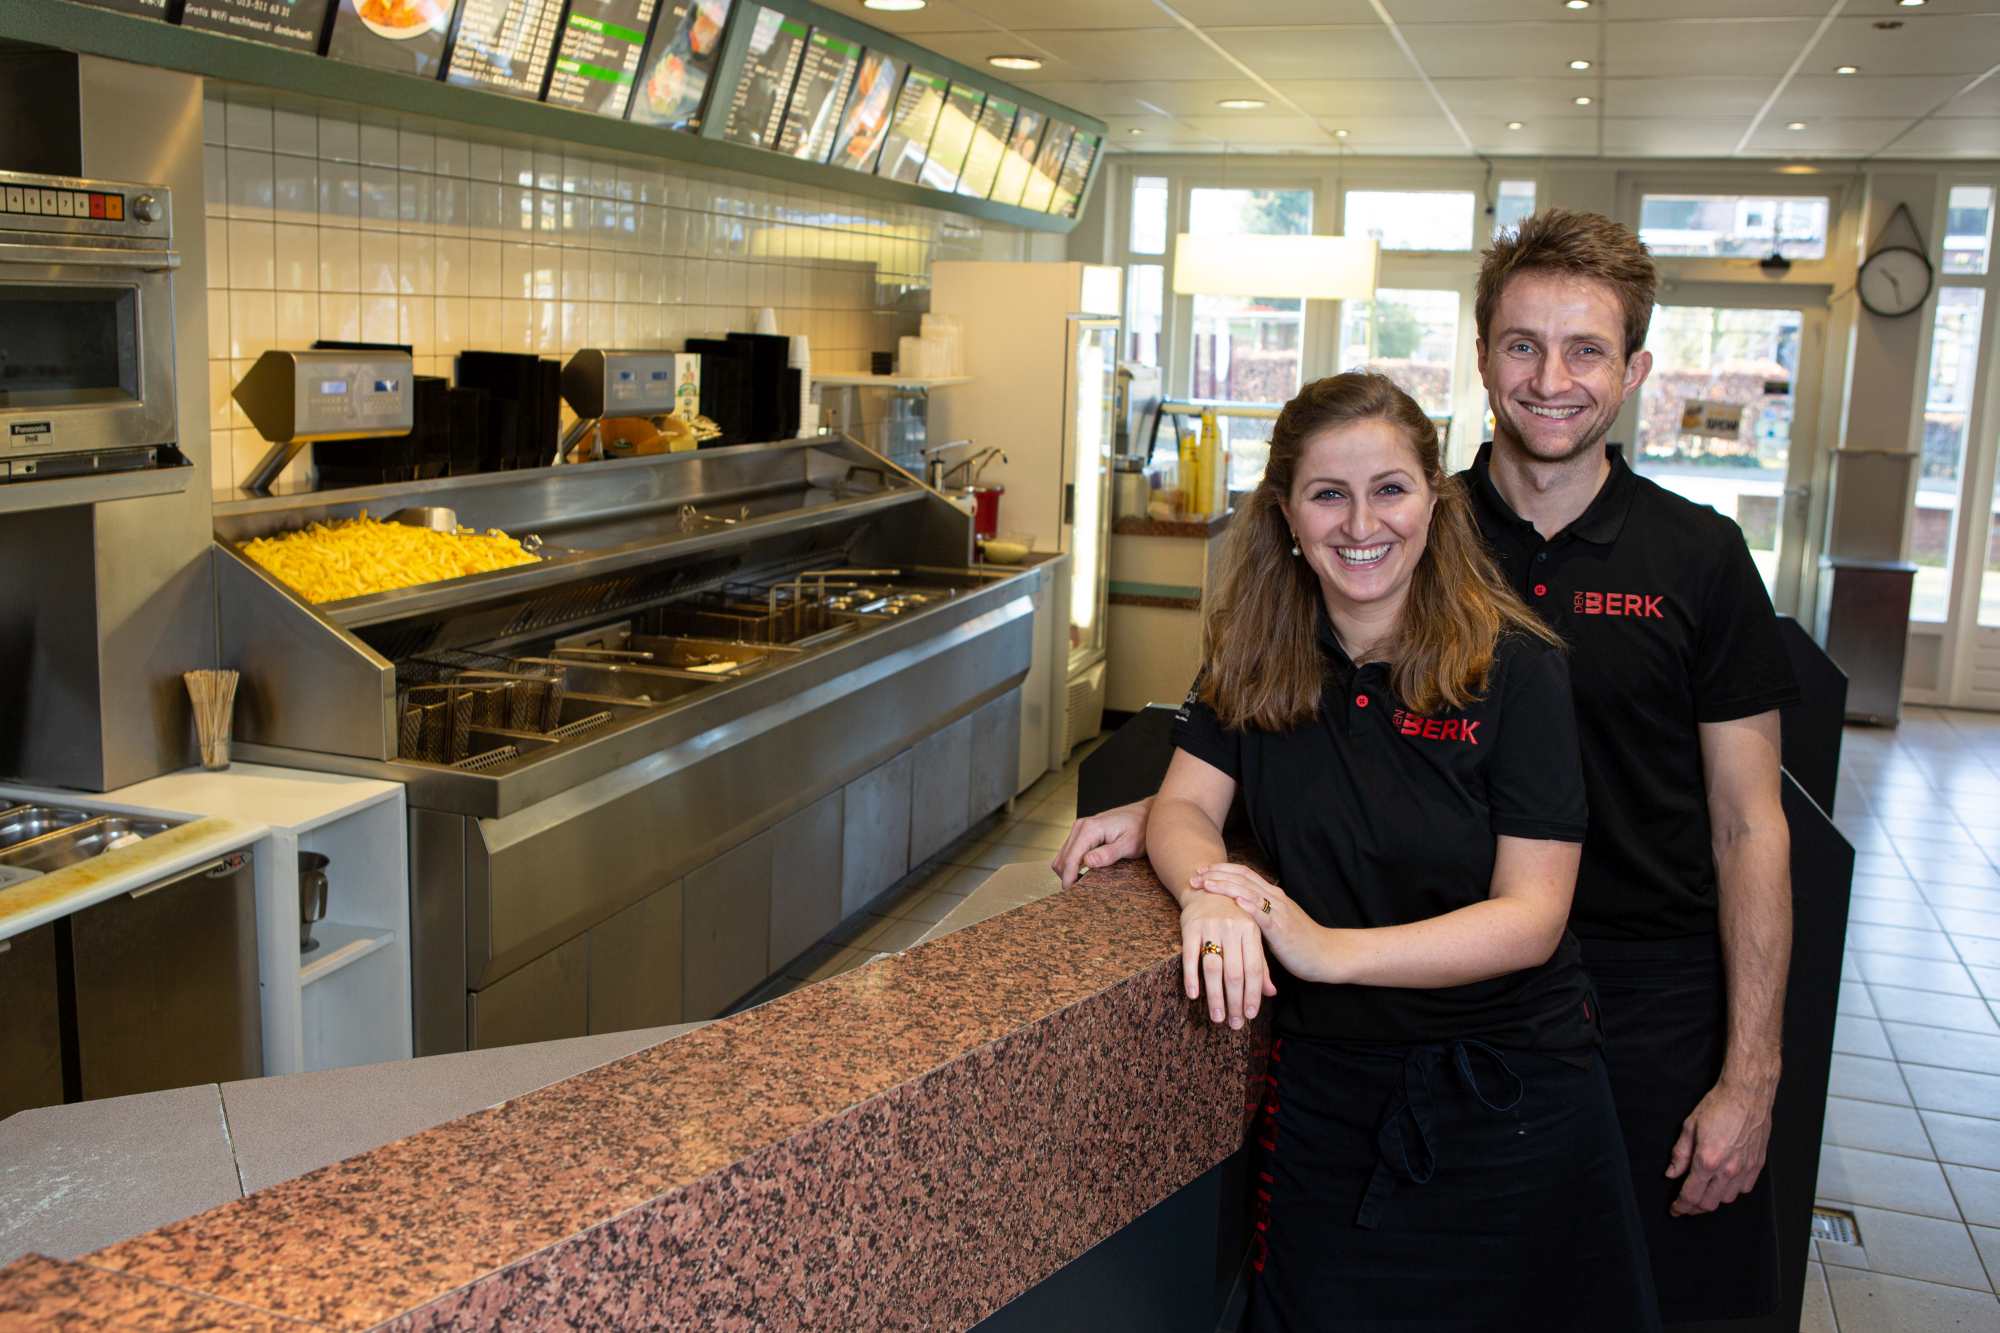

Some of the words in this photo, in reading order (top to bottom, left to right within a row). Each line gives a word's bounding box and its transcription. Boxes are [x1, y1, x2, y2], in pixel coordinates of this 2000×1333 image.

[185, 3, 208, 17] Gratis
[1574, 591, 1584, 614] DEN
[1585, 591, 1664, 618] BERK
[1401, 713, 1480, 744] BERK
